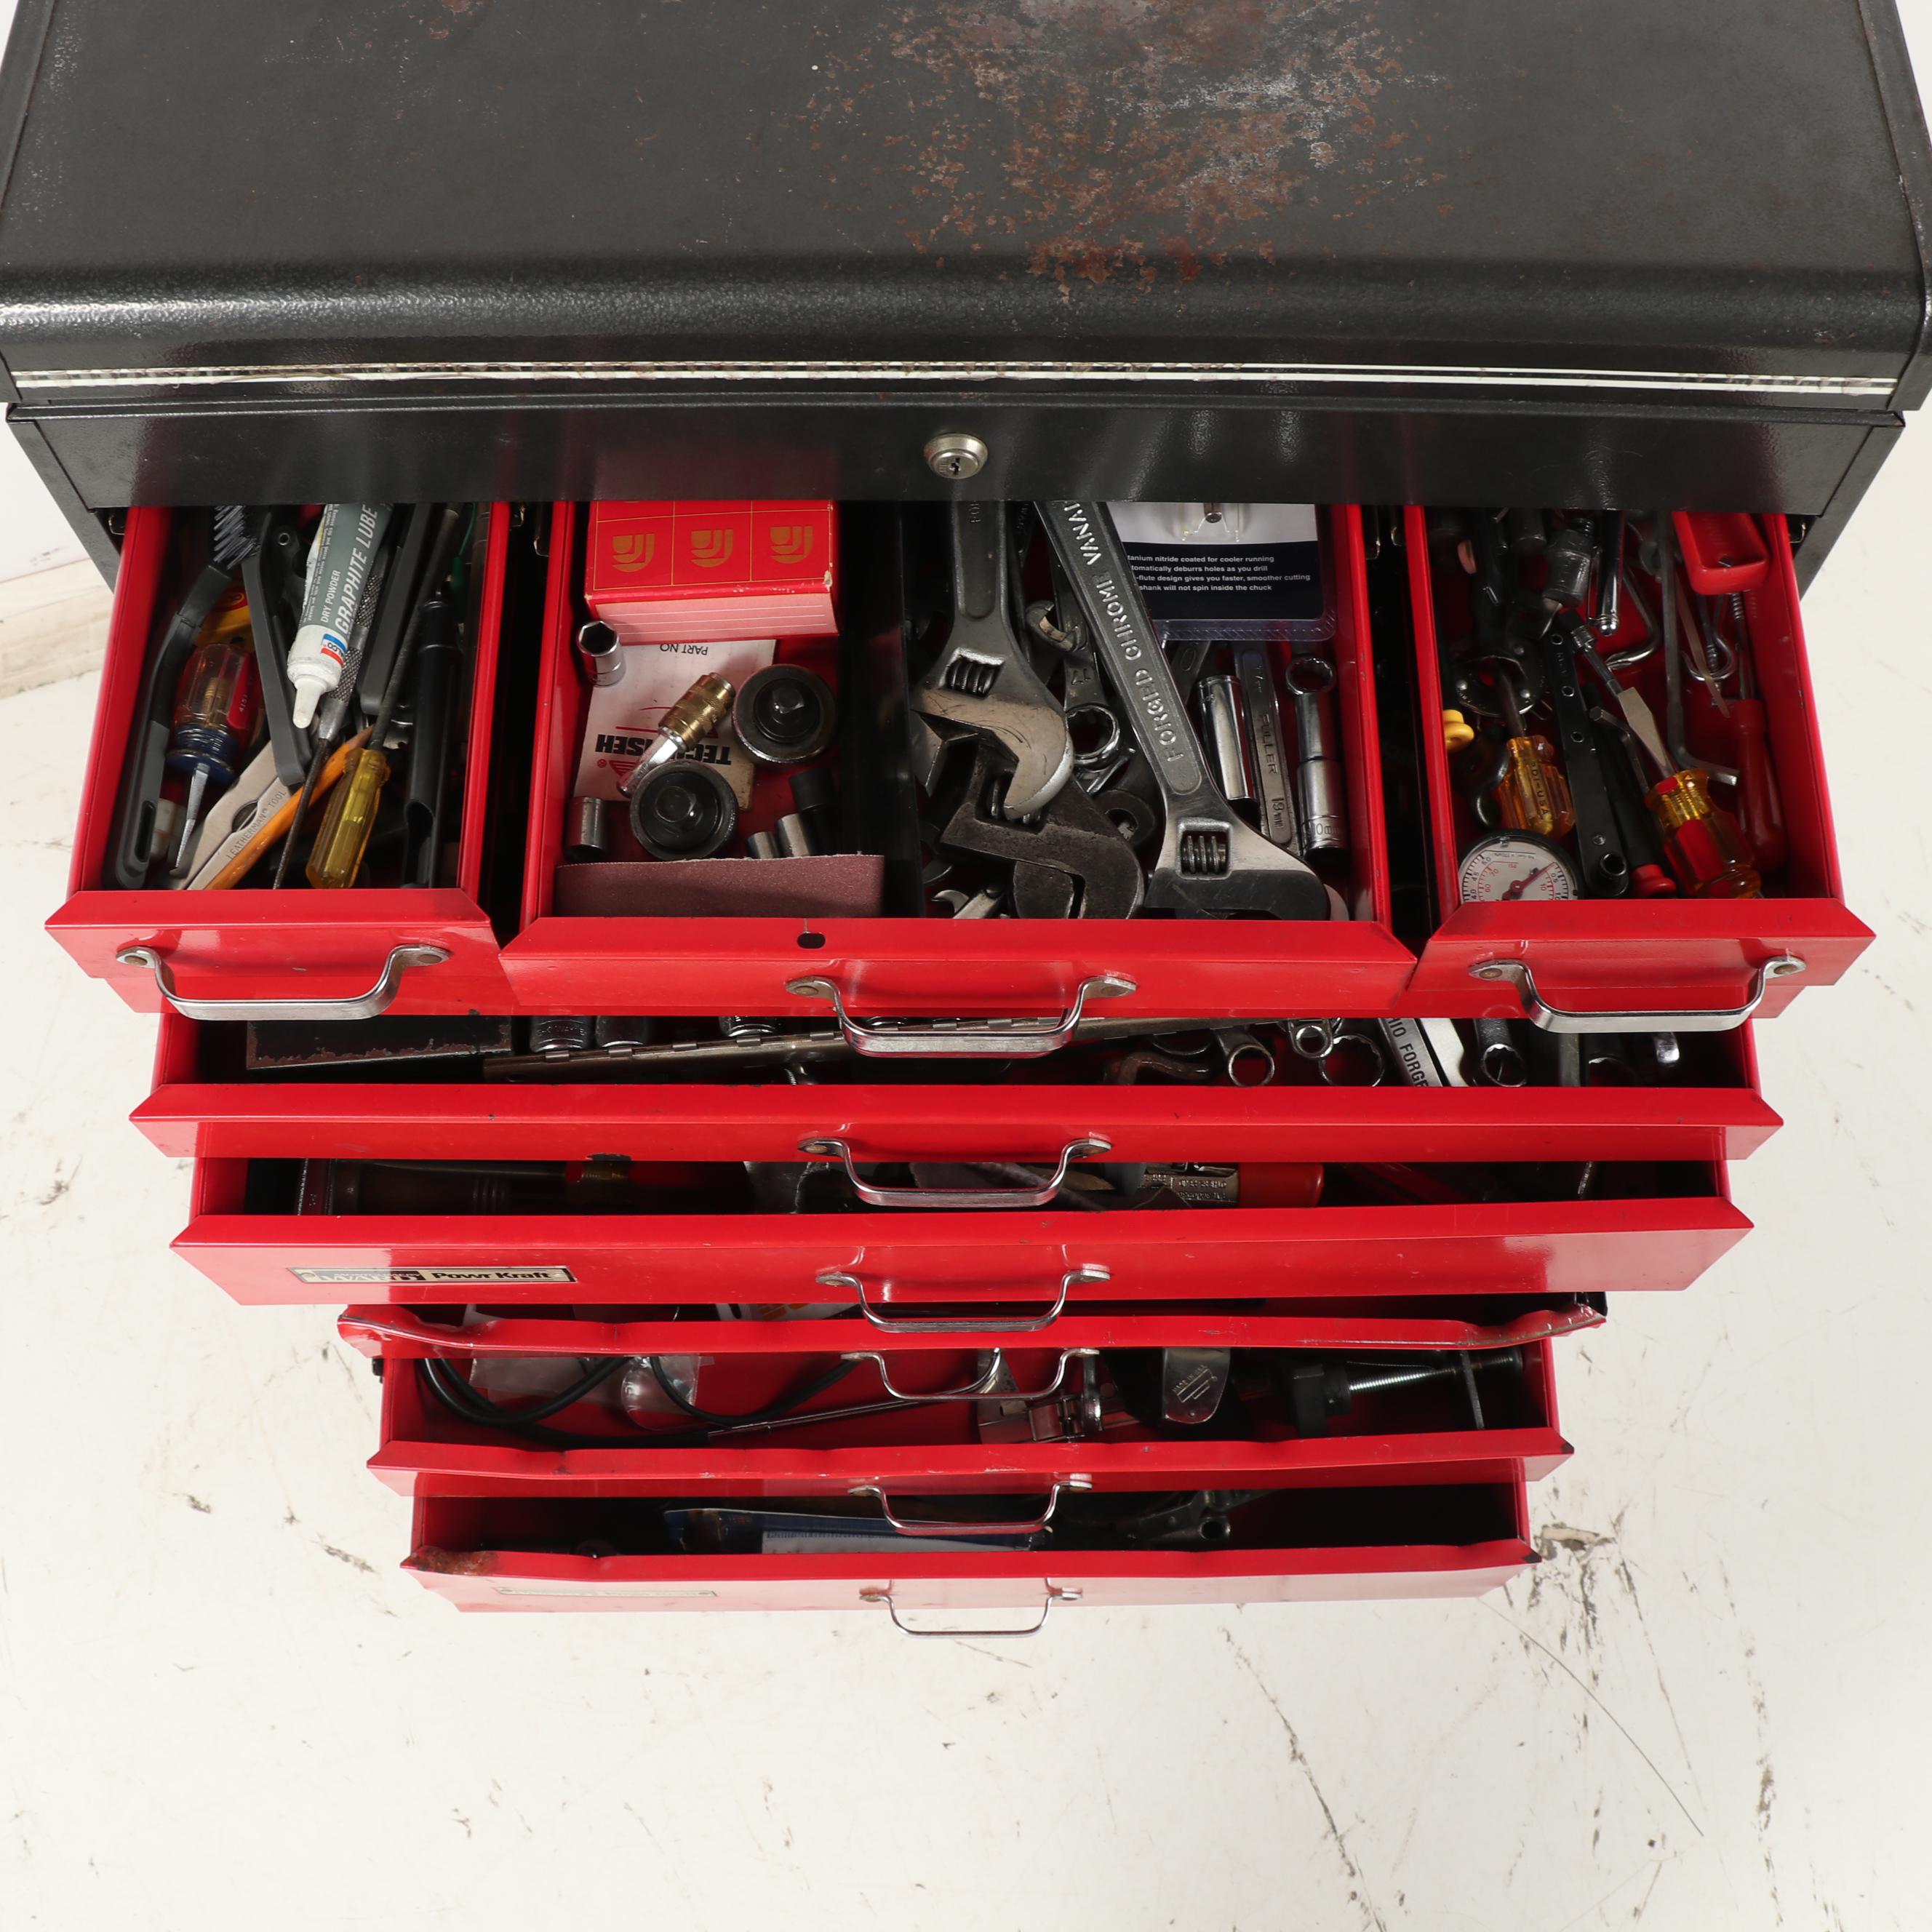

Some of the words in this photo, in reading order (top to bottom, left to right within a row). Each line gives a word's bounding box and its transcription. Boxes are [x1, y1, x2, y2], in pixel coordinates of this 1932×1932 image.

[335, 547, 367, 634] GRAPHITE
[355, 504, 378, 549] LUBE
[320, 604, 332, 623] DRY
[326, 570, 341, 603] POWDER
[1092, 570, 1142, 661] CHROME
[659, 643, 680, 653] NO
[681, 645, 708, 655] PART
[1135, 668, 1185, 762] FORGED
[595, 734, 732, 765] TECSEH
[1259, 713, 1279, 775] FULLER
[268, 790, 287, 808] TOOL
